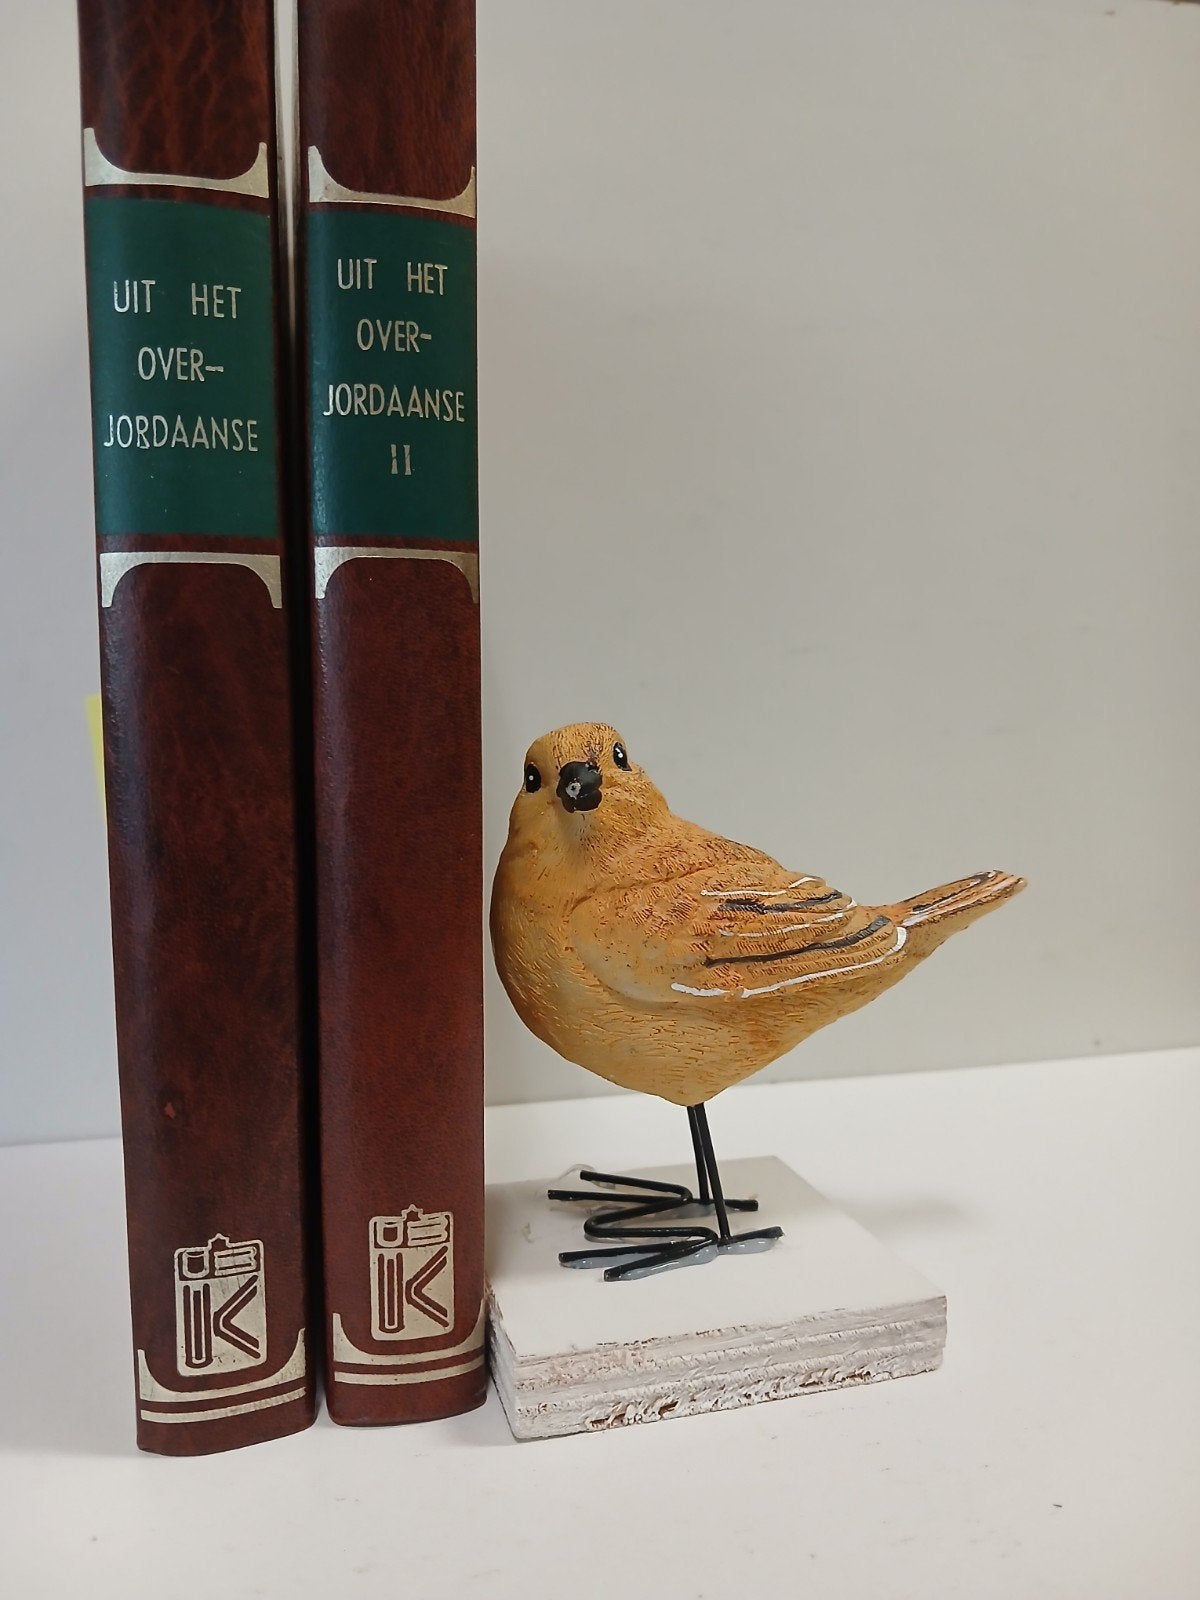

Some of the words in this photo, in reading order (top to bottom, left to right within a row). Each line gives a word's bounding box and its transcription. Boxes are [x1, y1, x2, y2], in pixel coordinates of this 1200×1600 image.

[336, 258, 378, 290] UIT
[406, 261, 448, 296] HET
[113, 279, 156, 314] UIT
[190, 282, 242, 319] HET
[356, 318, 432, 353] OVER-
[137, 346, 224, 382] OVER-
[322, 383, 465, 423] JORDAANSE
[103, 414, 259, 452] JORDAANSE
[390, 444, 412, 476] II
